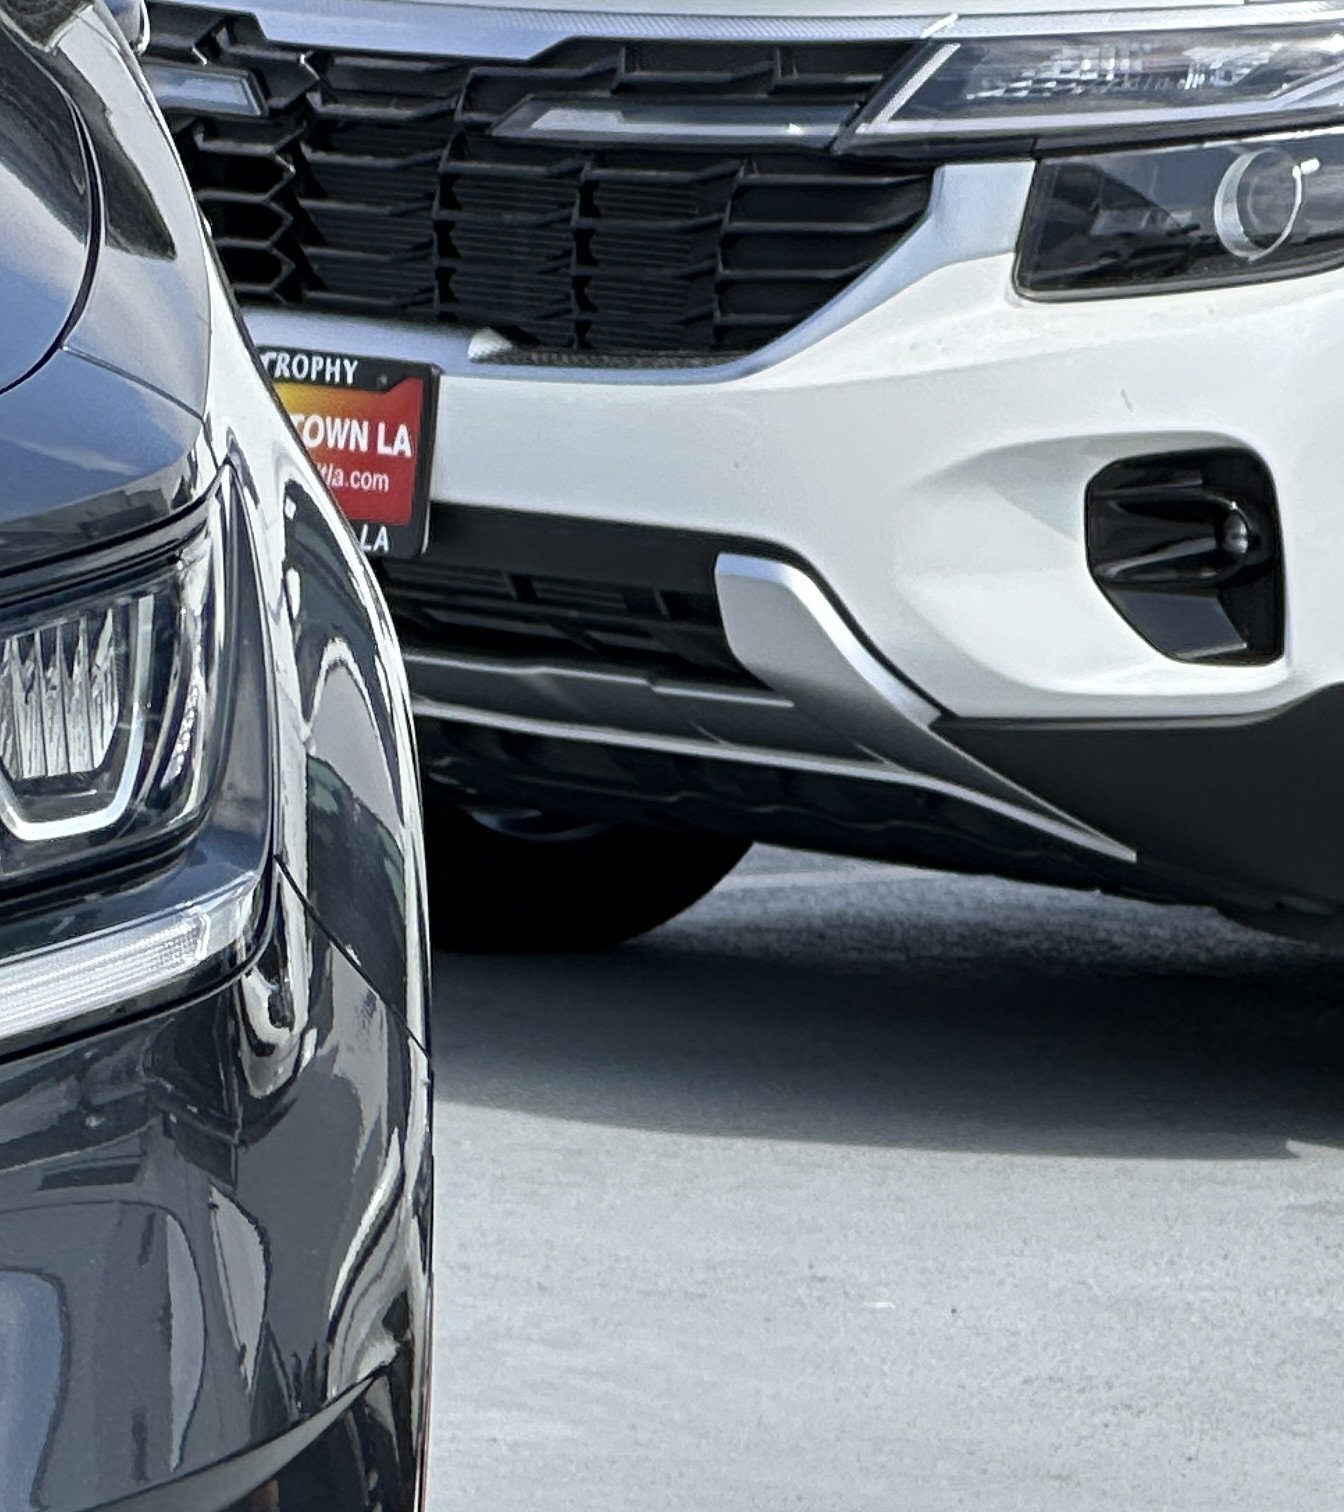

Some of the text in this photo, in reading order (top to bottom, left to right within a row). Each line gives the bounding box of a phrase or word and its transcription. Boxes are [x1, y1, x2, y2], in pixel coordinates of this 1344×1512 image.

[260, 352, 358, 384] TROPHY
[377, 421, 412, 457] LA
[360, 523, 389, 553] LA
